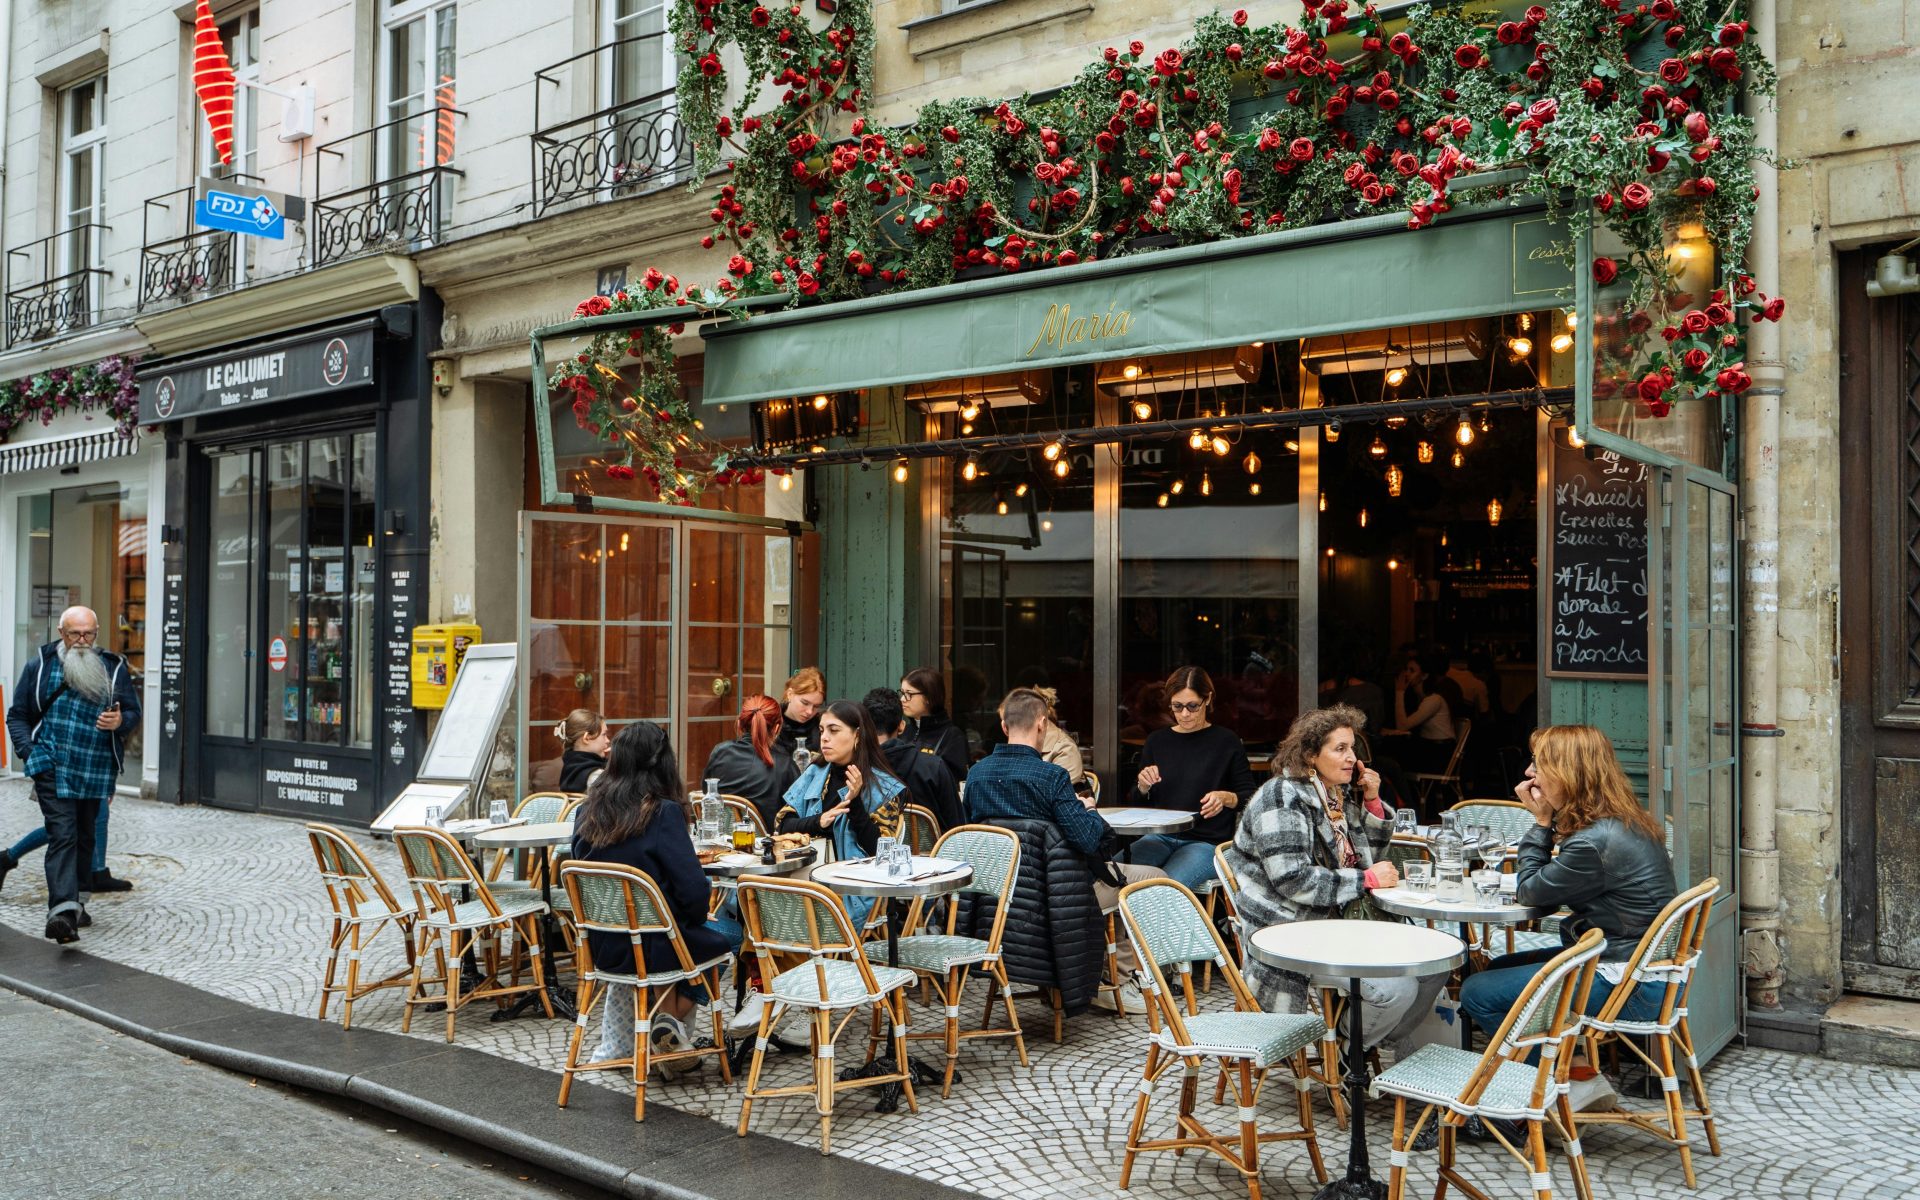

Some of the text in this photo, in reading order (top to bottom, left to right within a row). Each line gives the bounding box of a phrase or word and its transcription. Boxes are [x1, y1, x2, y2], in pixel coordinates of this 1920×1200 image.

[211, 196, 246, 214] FDJ
[600, 270, 624, 296] 47
[1026, 298, 1136, 357] María
[206, 352, 286, 390] LE CALUMET
[220, 392, 240, 406] Tabac
[251, 386, 268, 400] Jeux
[1570, 474, 1644, 508] Ravioli
[1560, 512, 1634, 528] Crevettes
[1557, 530, 1608, 546] Sauce
[1574, 562, 1629, 594] Filet
[1558, 592, 1629, 616] dorade
[1576, 618, 1601, 639] la
[1557, 638, 1648, 664] Plancha
[294, 758, 328, 770] EN VENTE ICI
[266, 769, 357, 792] DISPOSITIFS ÉLECTRONIQUES
[278, 786, 344, 806] DE VAPOTAGE ET BOX
